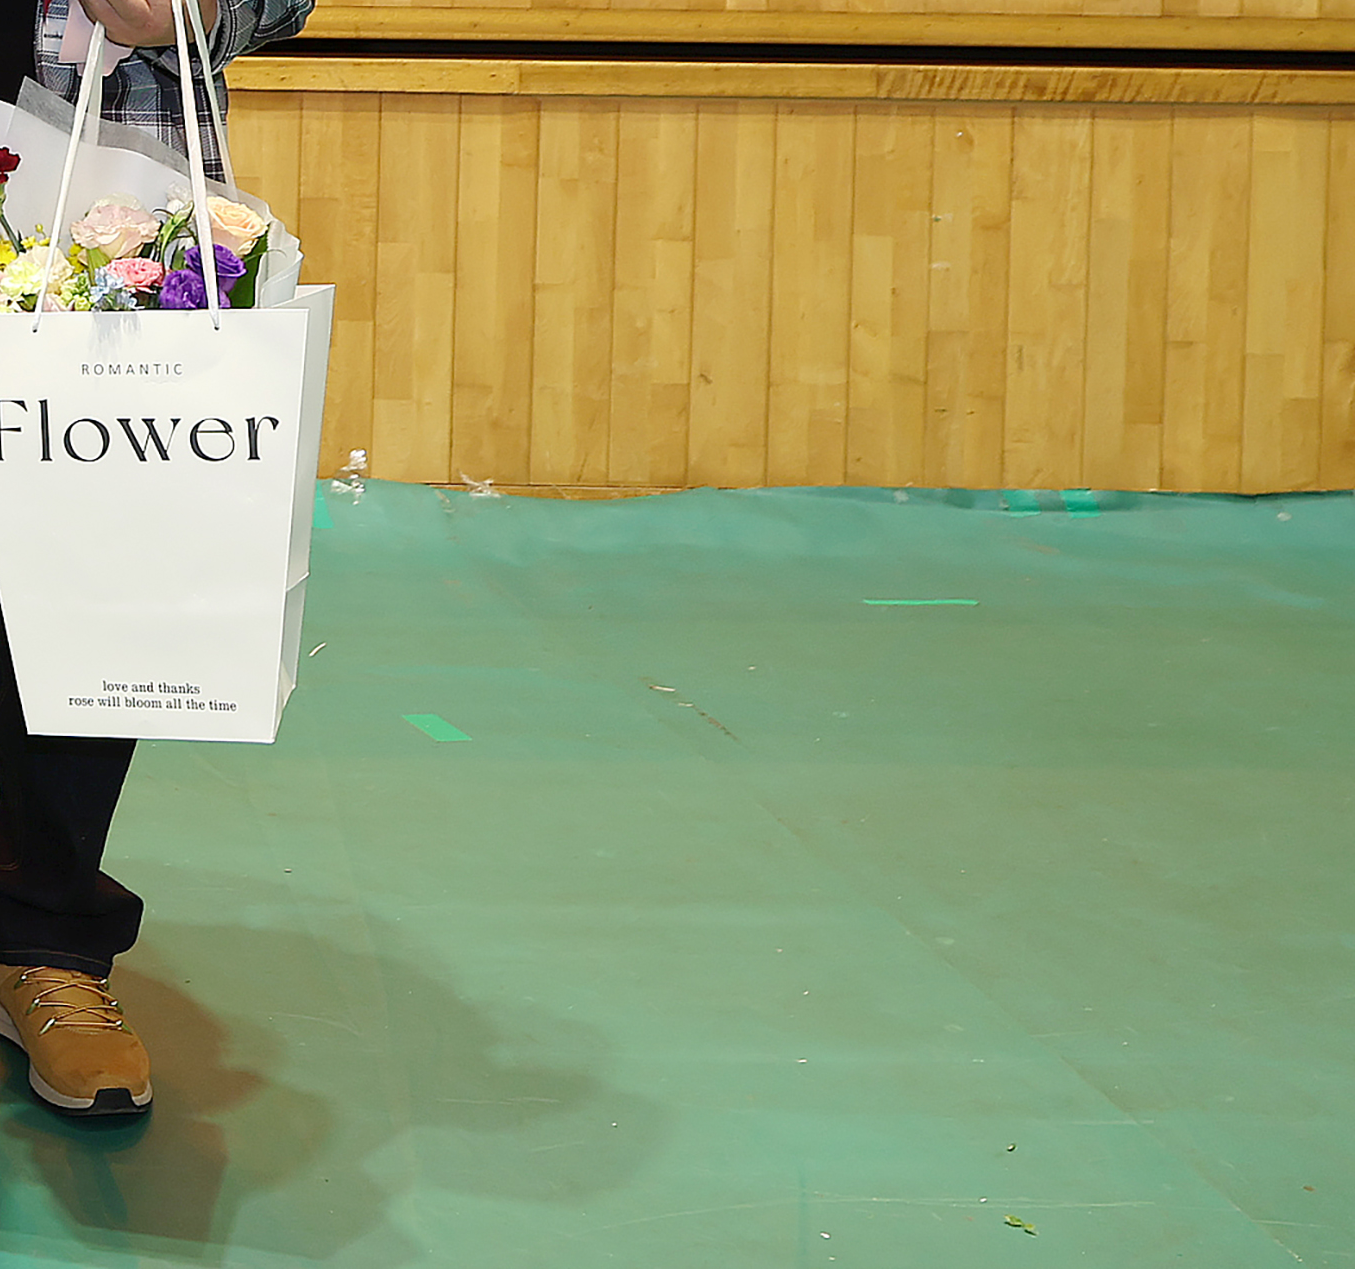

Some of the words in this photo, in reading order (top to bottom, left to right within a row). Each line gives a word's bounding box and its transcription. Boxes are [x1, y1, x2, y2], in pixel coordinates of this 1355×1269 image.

[82, 364, 182, 375] ROMANTIC
[103, 680, 128, 692] love
[132, 682, 154, 692] and
[158, 682, 200, 694] thanks
[69, 698, 94, 706] rose
[97, 696, 120, 707] will
[125, 697, 162, 708] bloom
[166, 698, 182, 709] all
[186, 699, 205, 710] the
[209, 700, 236, 711] time
